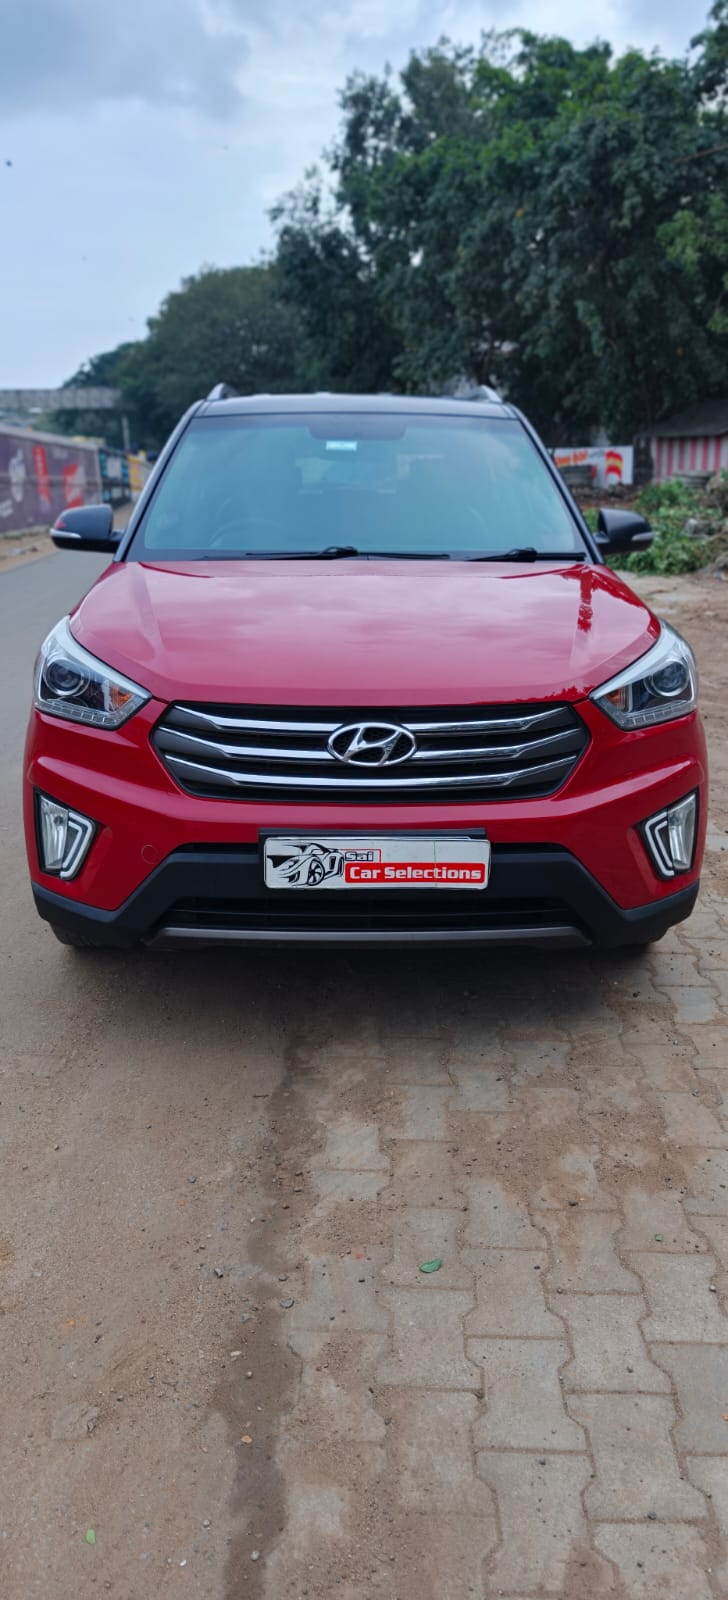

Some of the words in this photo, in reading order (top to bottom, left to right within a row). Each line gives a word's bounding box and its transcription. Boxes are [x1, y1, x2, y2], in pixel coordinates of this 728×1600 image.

[344, 850, 374, 862] Sai
[349, 866, 381, 879] Car
[384, 866, 481, 880] Selections
